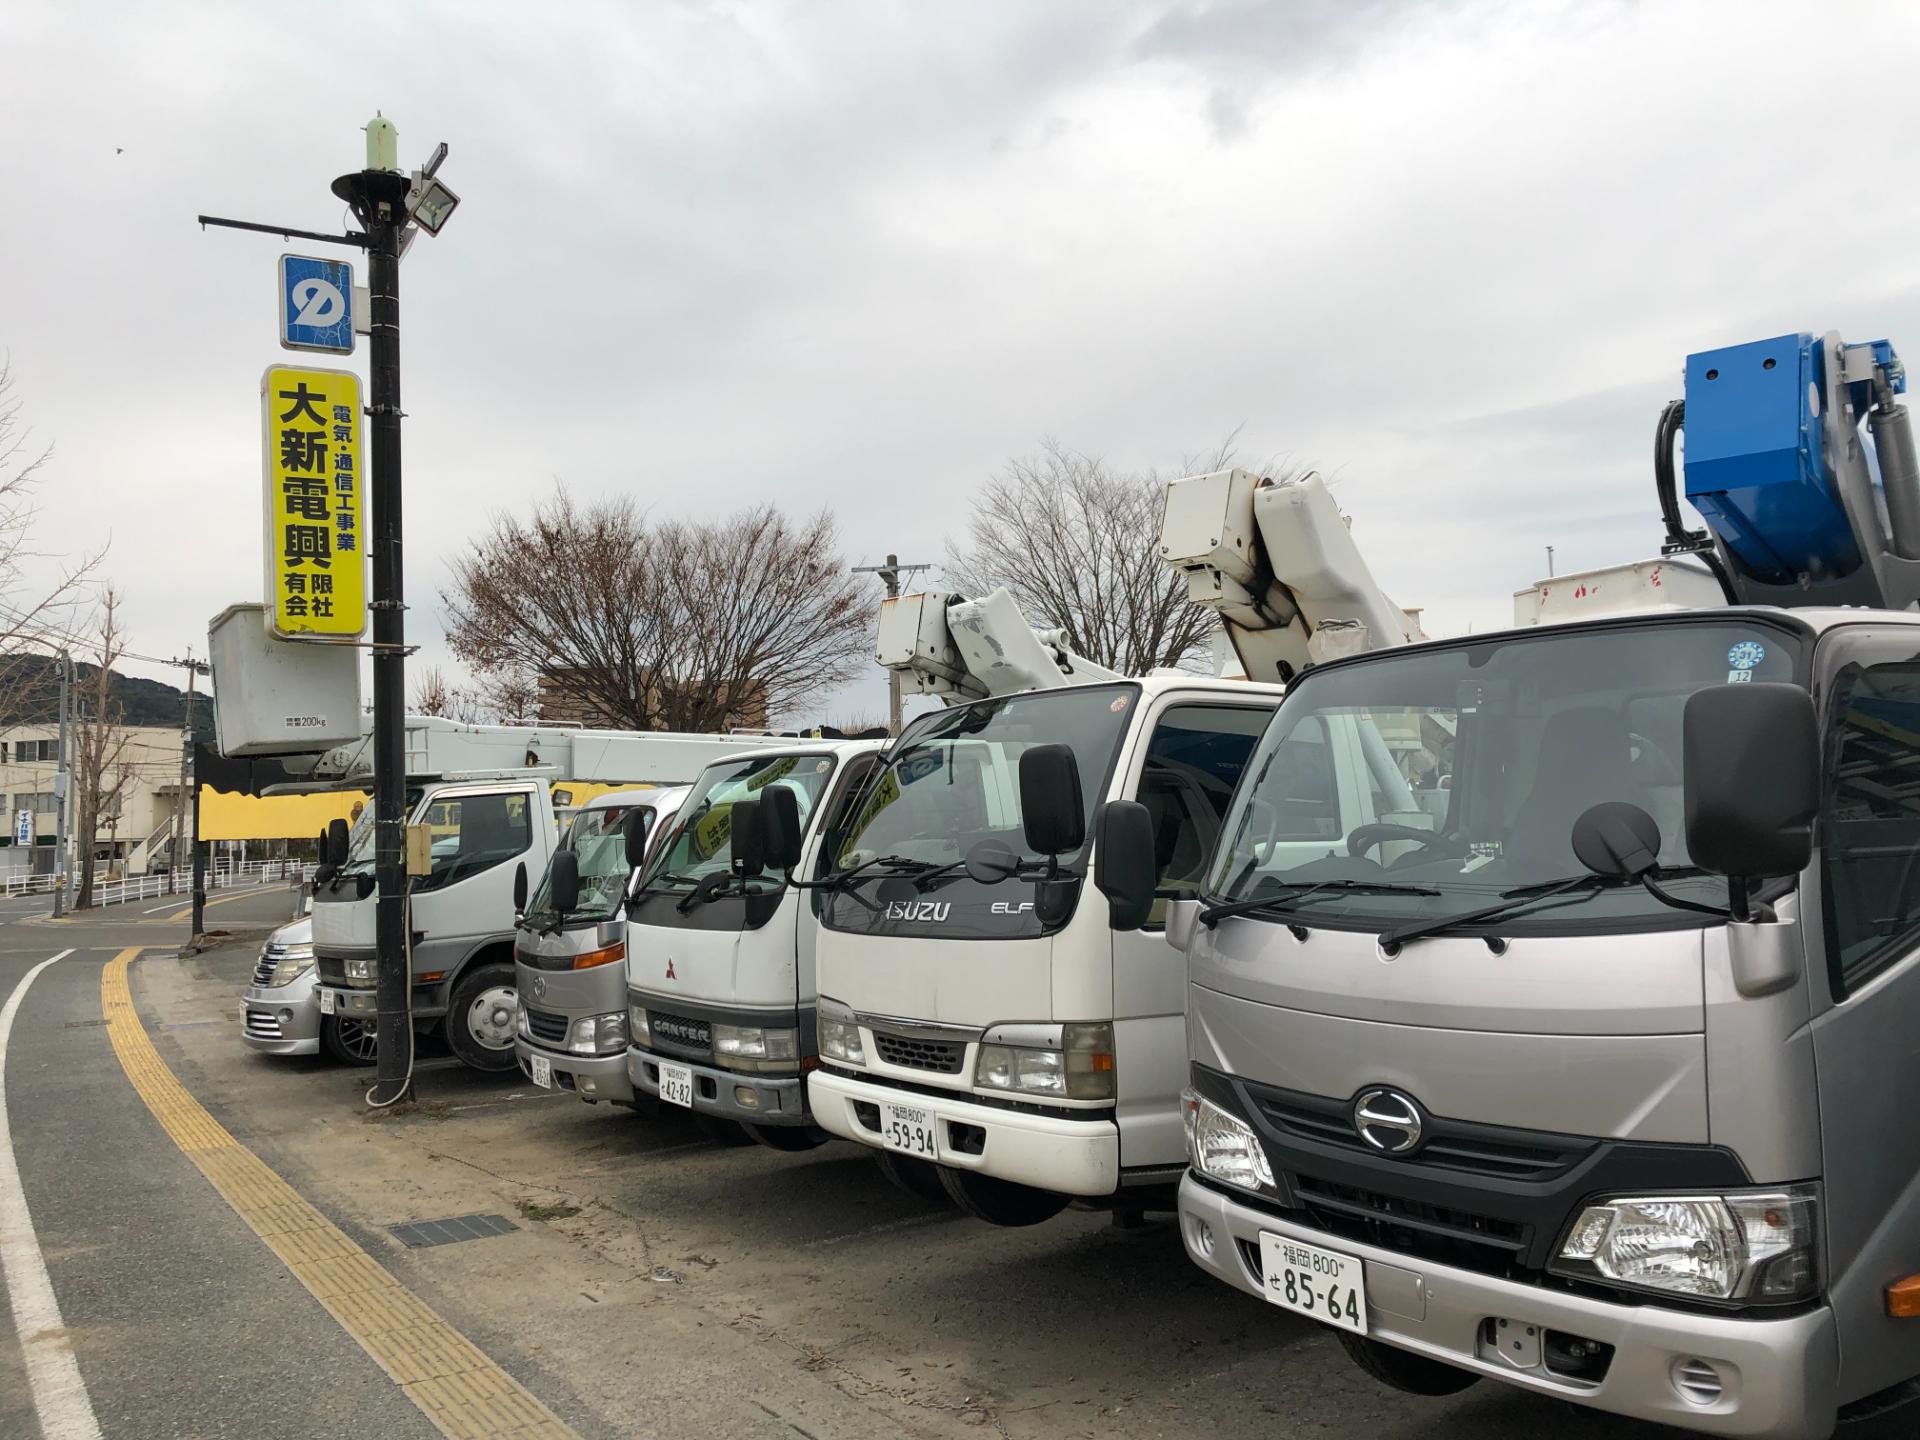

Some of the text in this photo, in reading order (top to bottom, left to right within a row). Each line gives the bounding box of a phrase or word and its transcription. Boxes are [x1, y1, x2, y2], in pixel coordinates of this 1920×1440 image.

[279, 382, 332, 570] 大新電興
[333, 405, 356, 551] 電気・通信工事業
[887, 901, 951, 921] ISUZU
[990, 902, 1034, 914] ELF
[653, 1020, 711, 1043] CANTER
[666, 1080, 690, 1104] 42-82
[908, 1108, 922, 1124] 800
[892, 1121, 934, 1156] 59-94
[1283, 1245, 1339, 1278] 福岡 800
[1269, 1268, 1360, 1327] せ 85-64
